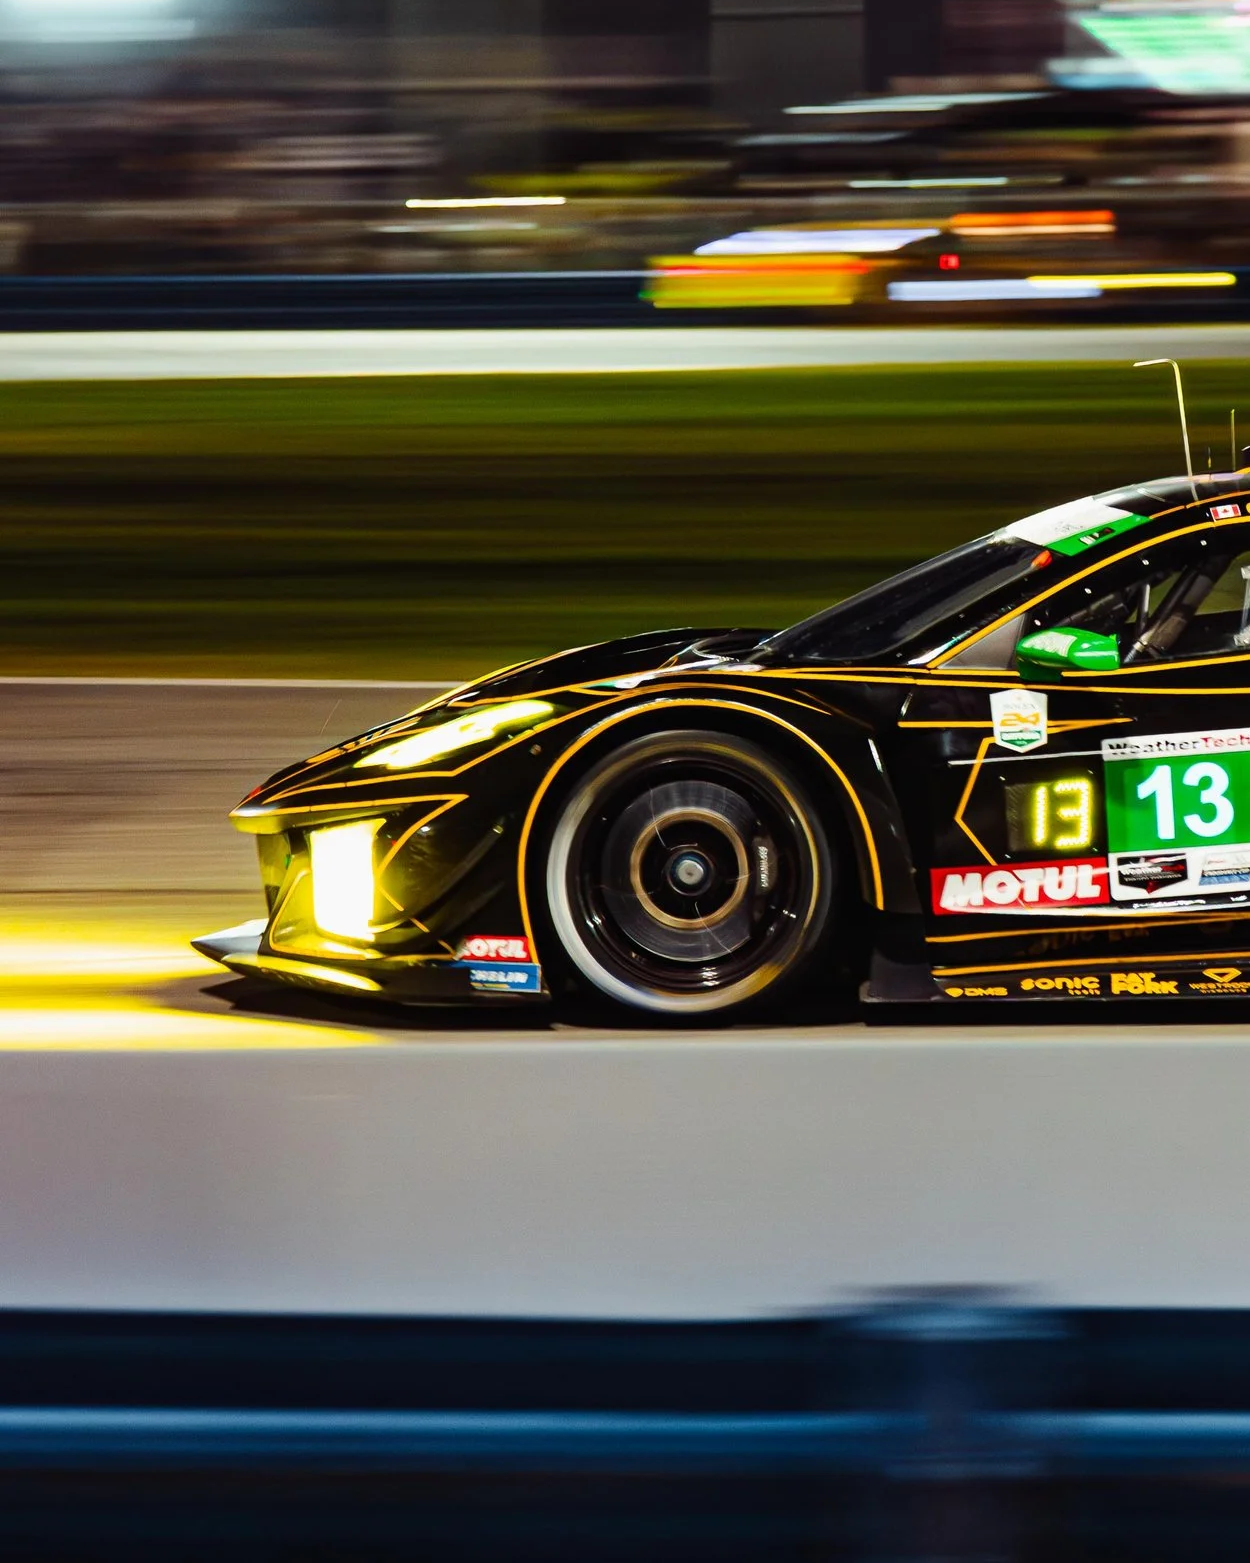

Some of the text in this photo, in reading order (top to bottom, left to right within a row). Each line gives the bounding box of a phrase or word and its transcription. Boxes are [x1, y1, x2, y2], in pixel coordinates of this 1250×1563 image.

[1033, 777, 1092, 850] 13
[1136, 761, 1235, 840] 13
[939, 864, 1102, 908] MOTUL
